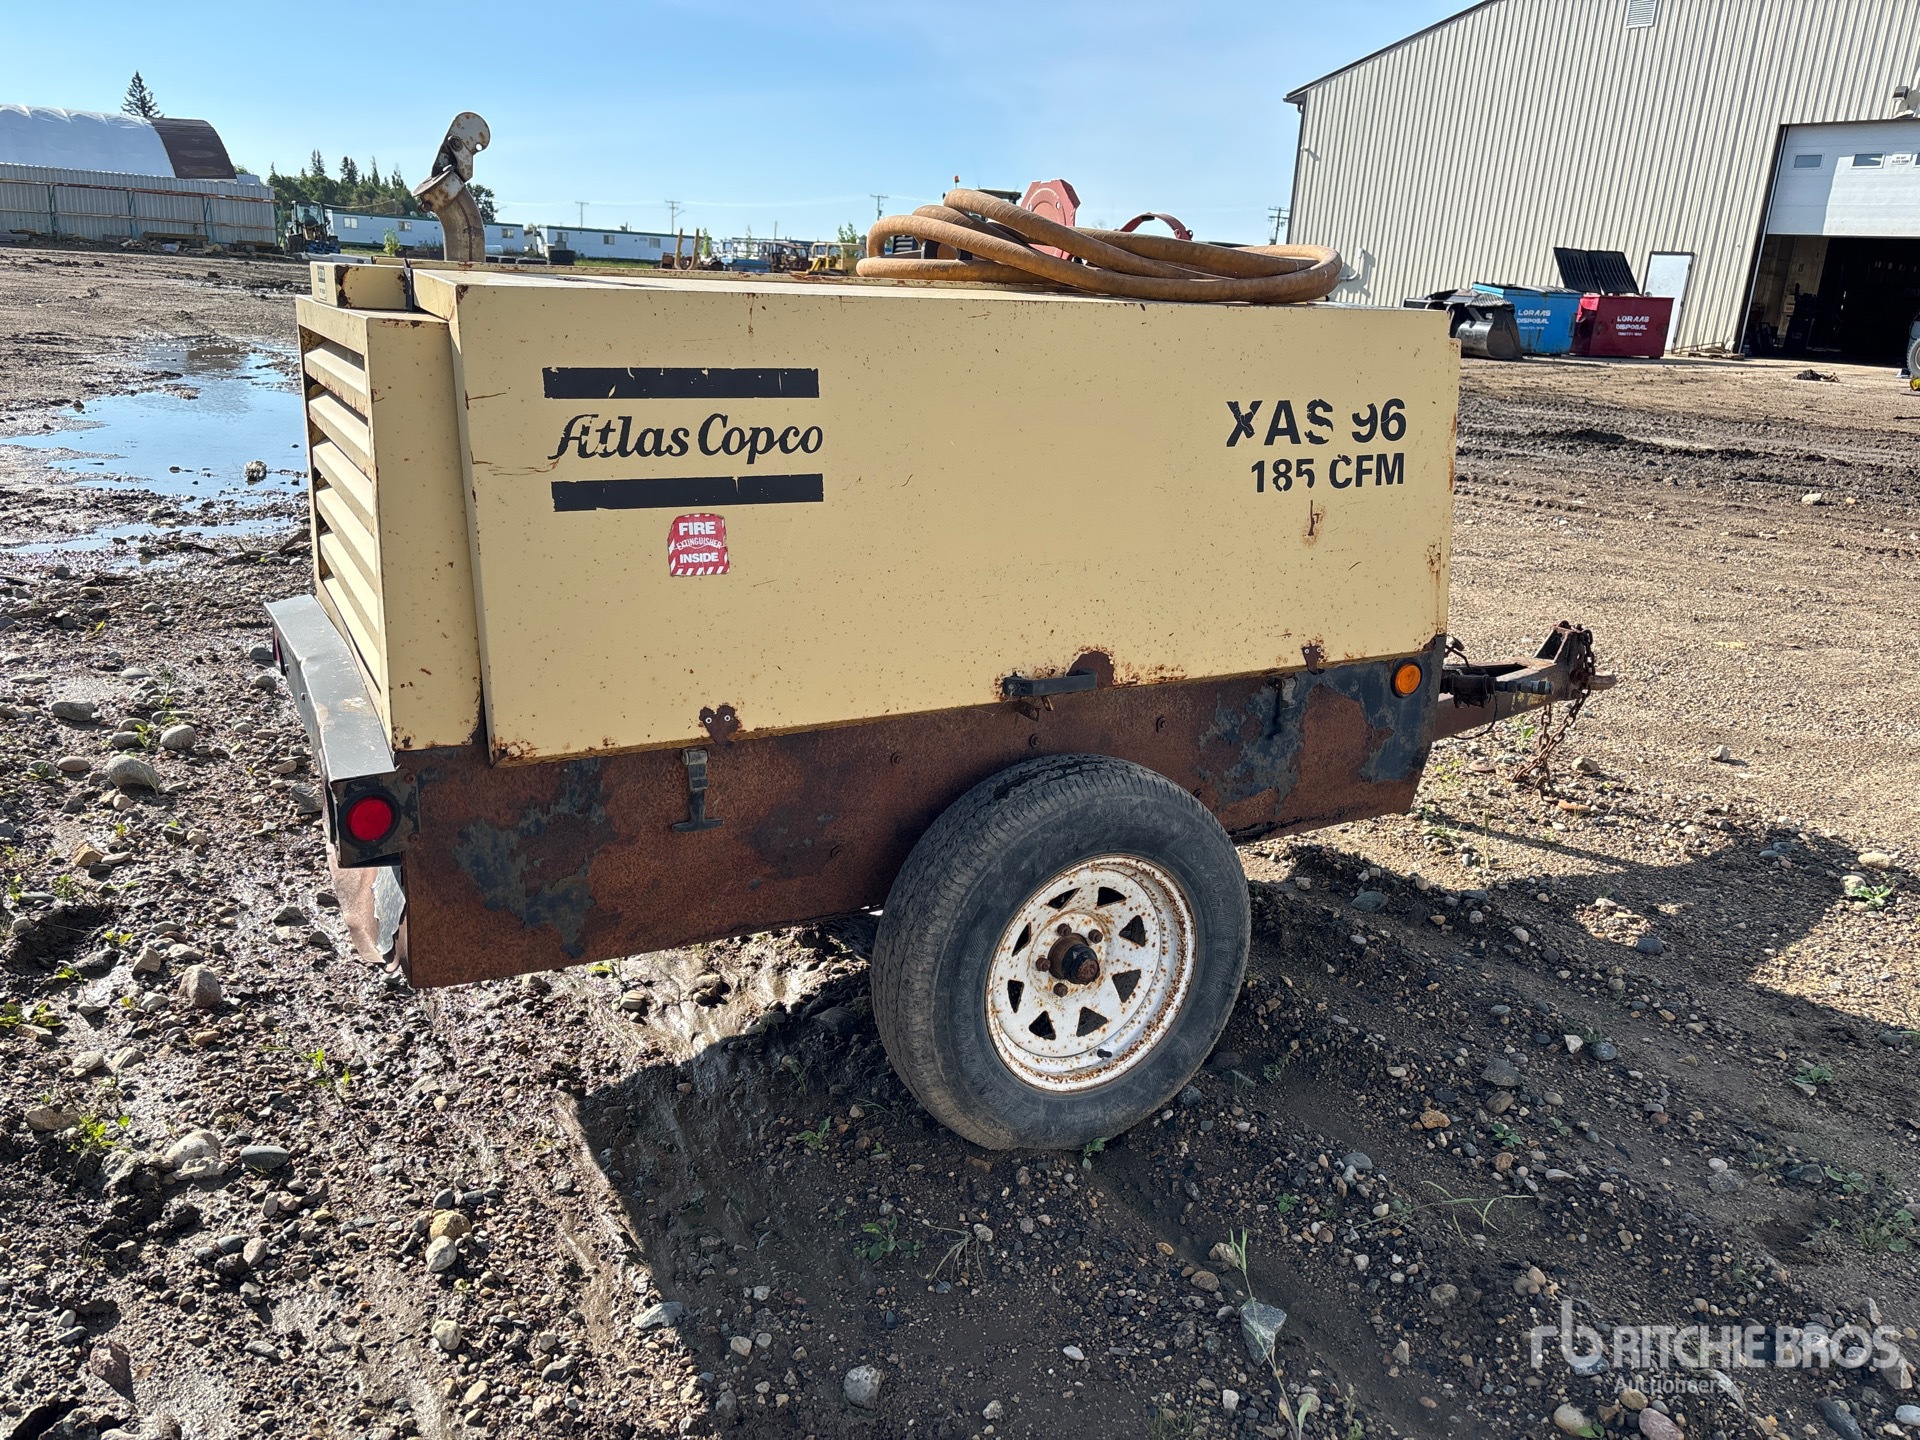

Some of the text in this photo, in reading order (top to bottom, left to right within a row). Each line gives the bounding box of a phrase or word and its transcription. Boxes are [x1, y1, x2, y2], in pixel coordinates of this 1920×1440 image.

[1616, 315, 1650, 323] LORAAS
[1226, 398, 1407, 447] XAS 96
[547, 413, 823, 465] Atlas Copco
[1251, 452, 1405, 493] 185 CFM
[678, 521, 716, 536] FIRE
[676, 537, 723, 551] EXTINGUISHER
[679, 552, 720, 564] INSIDE
